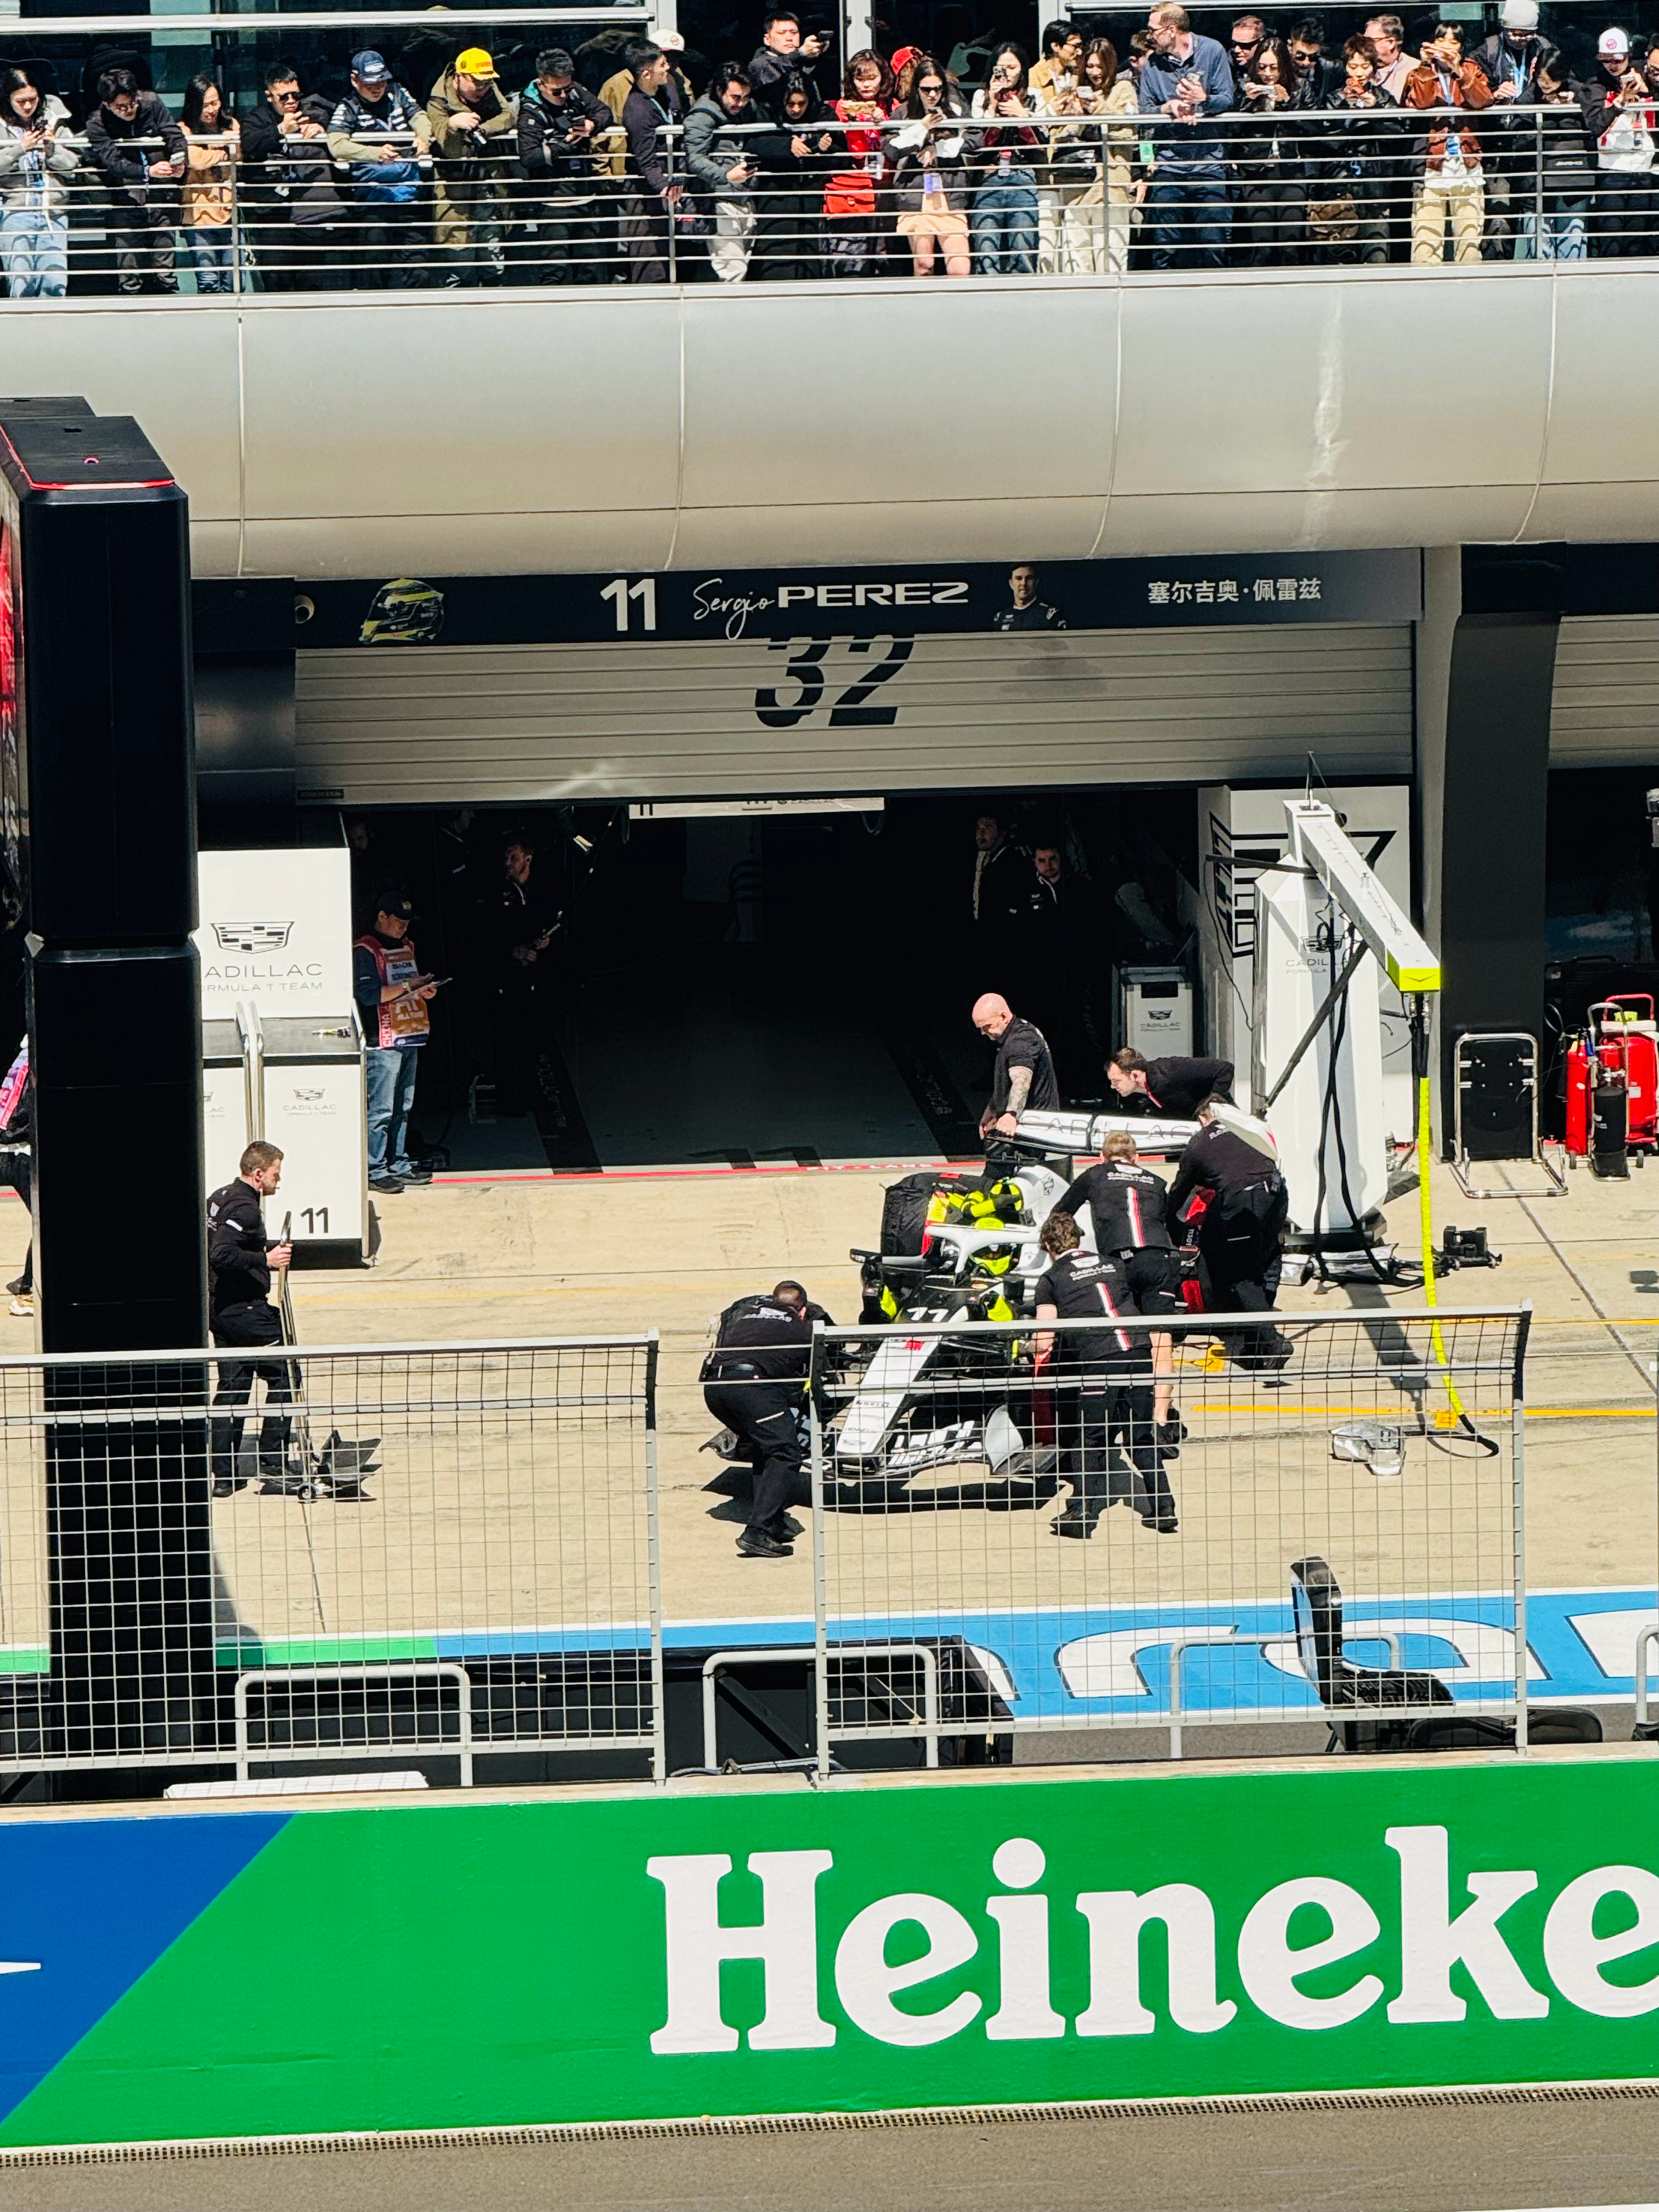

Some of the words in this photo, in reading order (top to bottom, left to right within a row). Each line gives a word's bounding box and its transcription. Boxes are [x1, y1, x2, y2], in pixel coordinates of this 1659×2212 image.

[600, 578, 656, 631] 11
[693, 578, 775, 640] Sergio
[778, 582, 969, 608] PEREZ
[1148, 577, 1322, 604] 塞尔吉奥·佩雷兹
[755, 635, 915, 727] 32
[202, 984, 262, 992] RMULA
[205, 963, 323, 978] ADILLAC
[301, 1207, 329, 1234] 11
[646, 1825, 1659, 2055] Heineke
